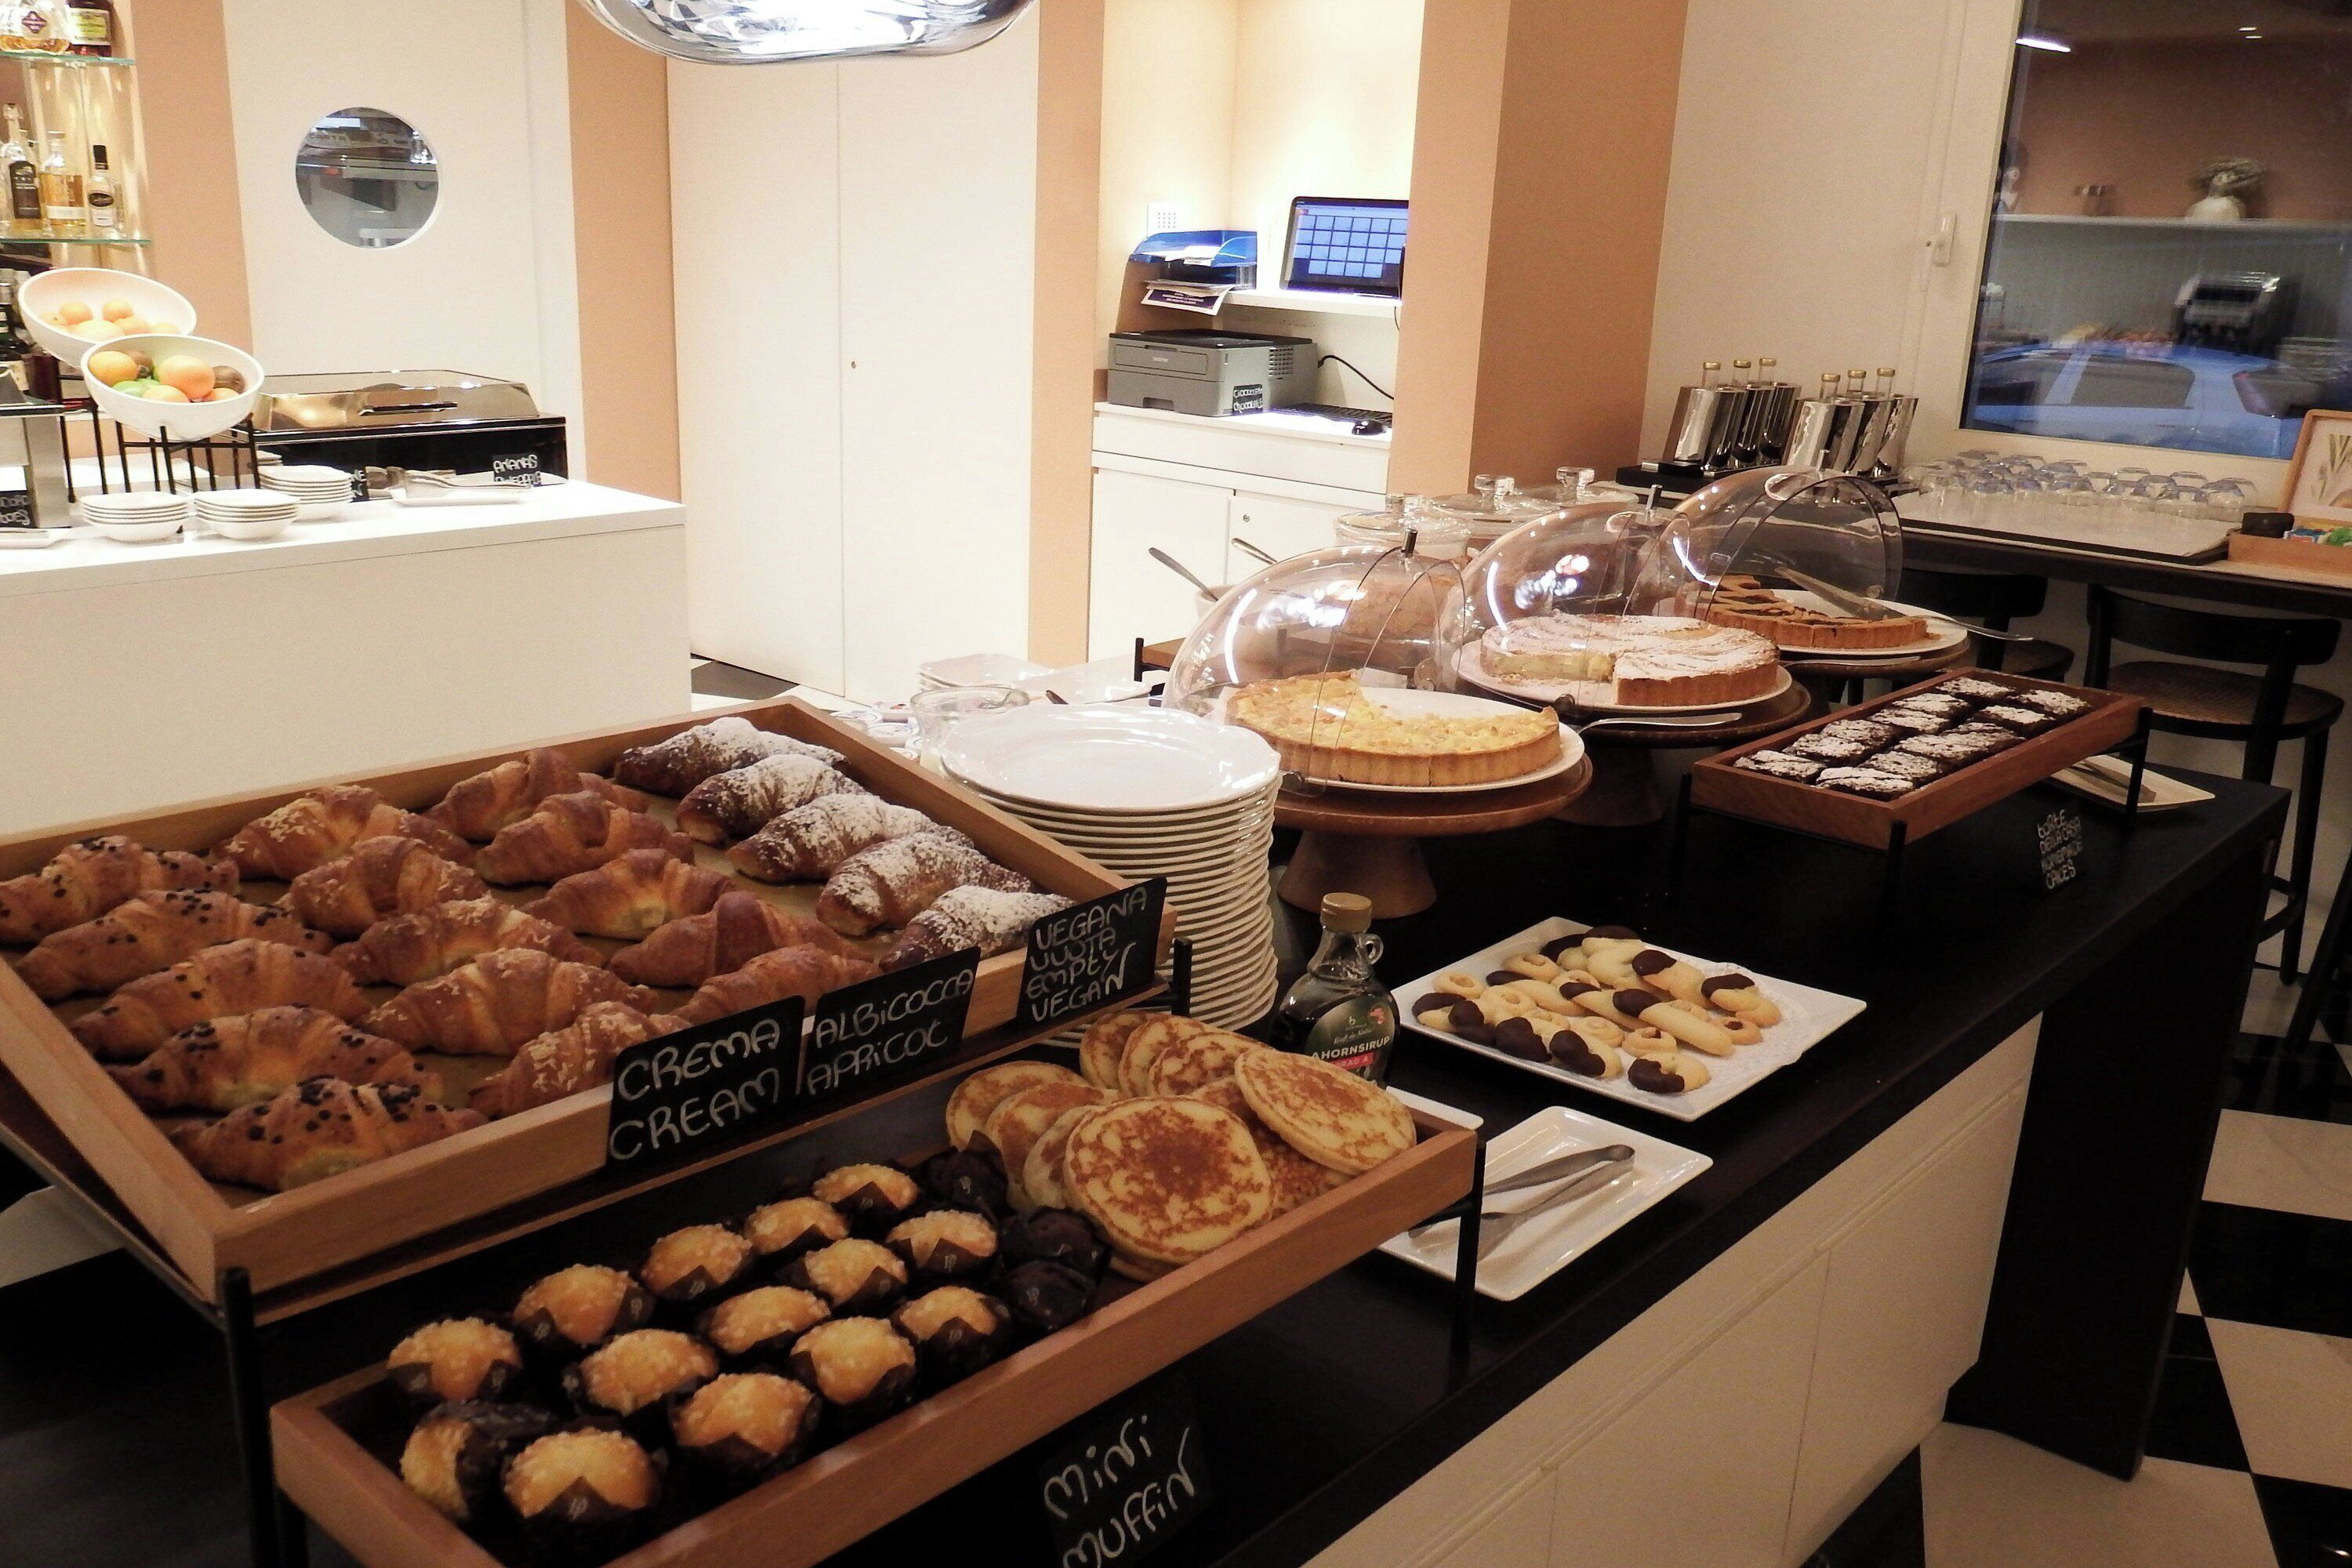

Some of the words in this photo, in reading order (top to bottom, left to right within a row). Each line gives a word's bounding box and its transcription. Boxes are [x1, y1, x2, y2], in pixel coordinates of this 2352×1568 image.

[1031, 942, 1136, 1022] VEGAN
[618, 1018, 781, 1101] CREMA
[1312, 1036, 1391, 1060] AHORNSIRUP
[609, 1067, 780, 1160] CREAM
